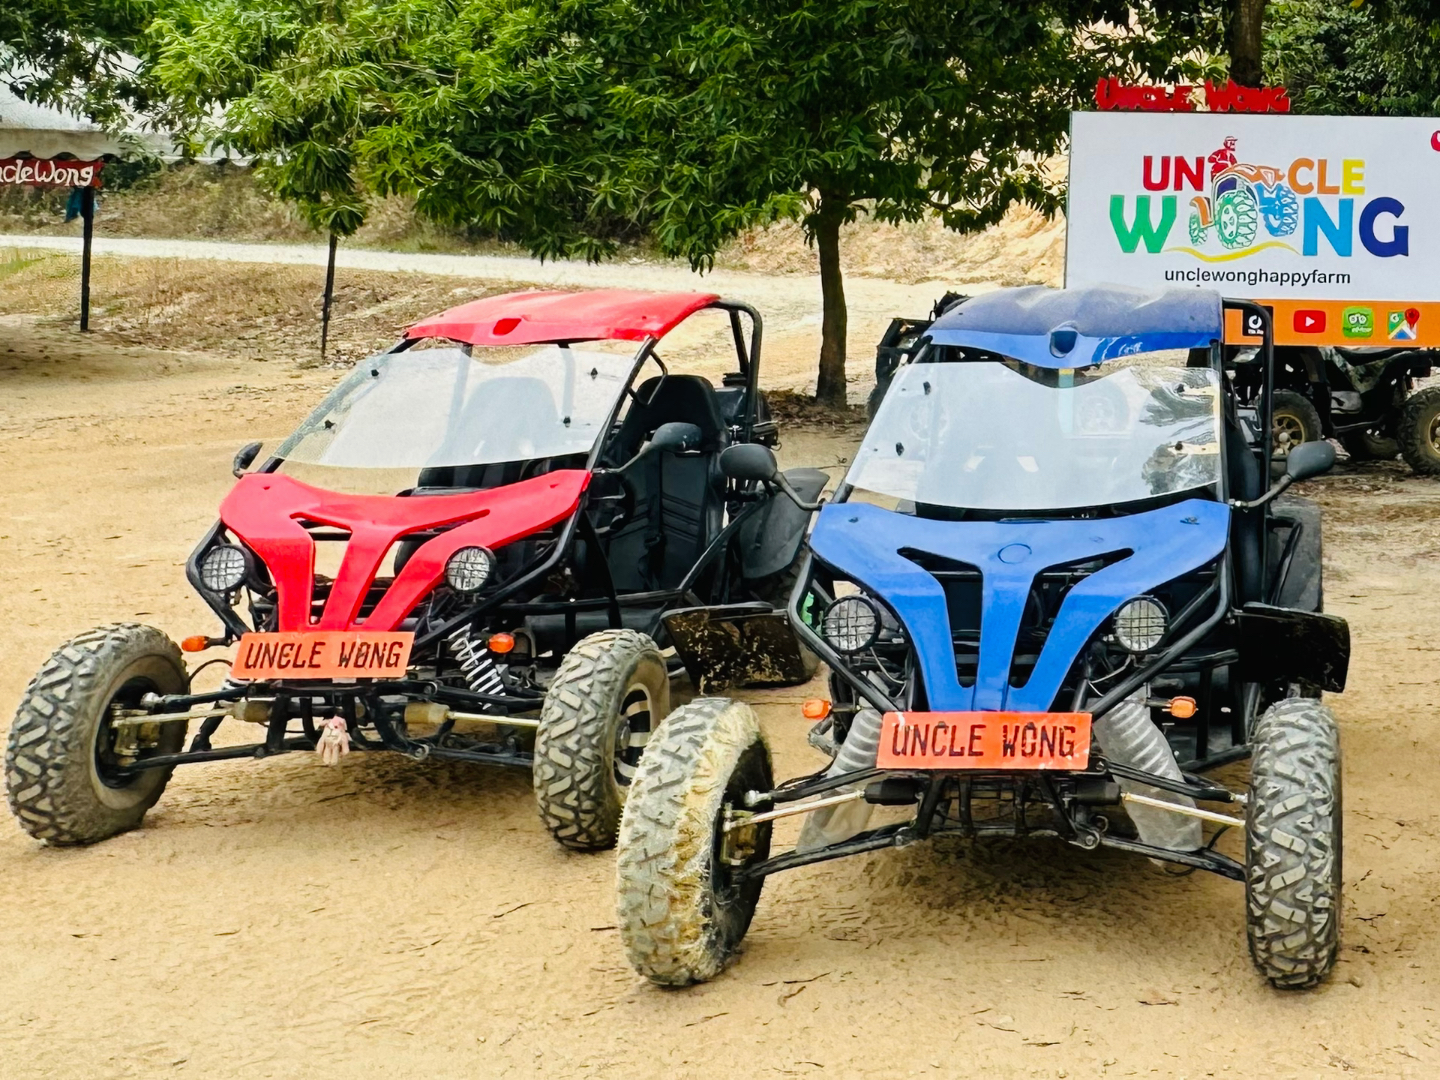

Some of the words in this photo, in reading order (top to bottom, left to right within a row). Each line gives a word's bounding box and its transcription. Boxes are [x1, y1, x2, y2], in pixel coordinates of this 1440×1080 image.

[1164, 267, 1351, 287] unclewonghappyfarm
[244, 641, 326, 669] UNCLE
[338, 641, 404, 669] WONG
[892, 723, 987, 757] UNCLE
[1002, 724, 1076, 758] WONG
